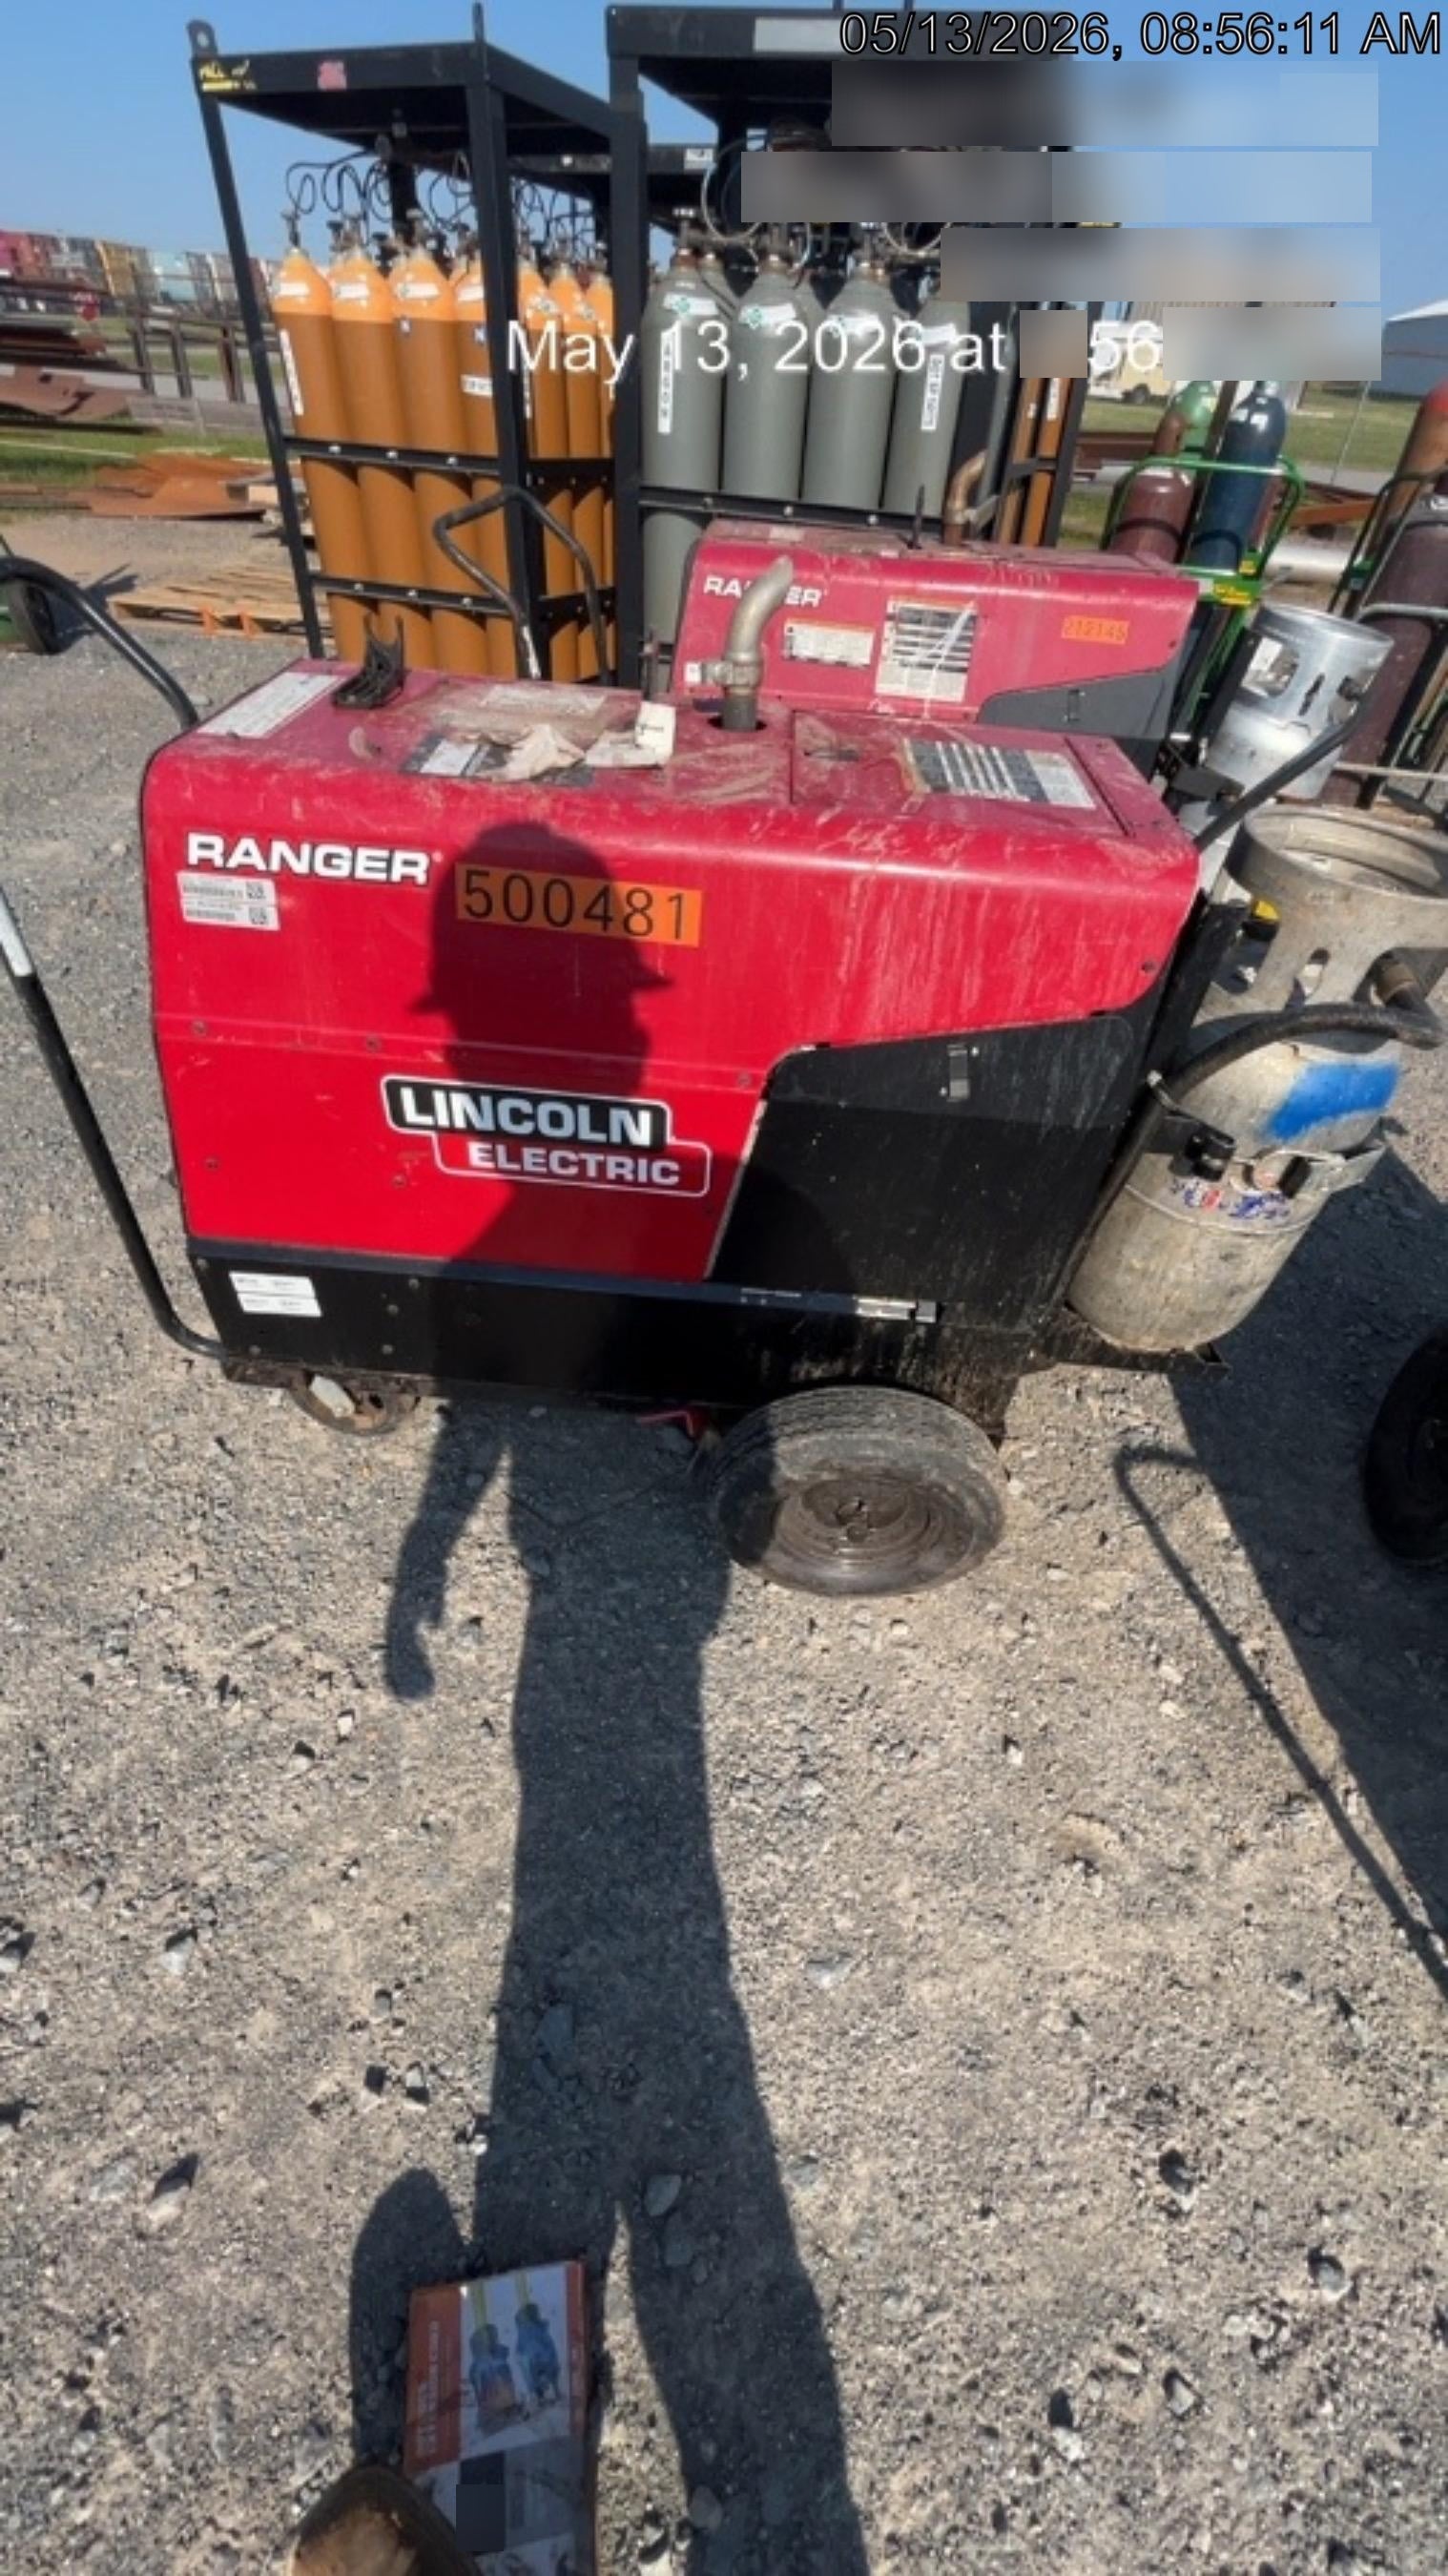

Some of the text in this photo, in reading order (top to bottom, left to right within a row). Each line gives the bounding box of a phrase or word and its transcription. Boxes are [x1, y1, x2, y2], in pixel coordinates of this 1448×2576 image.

[186, 831, 429, 885] RANGER
[465, 868, 687, 942] 500481
[400, 1086, 652, 1148] LINCOLN
[467, 1140, 679, 1187] ELECTRIC
